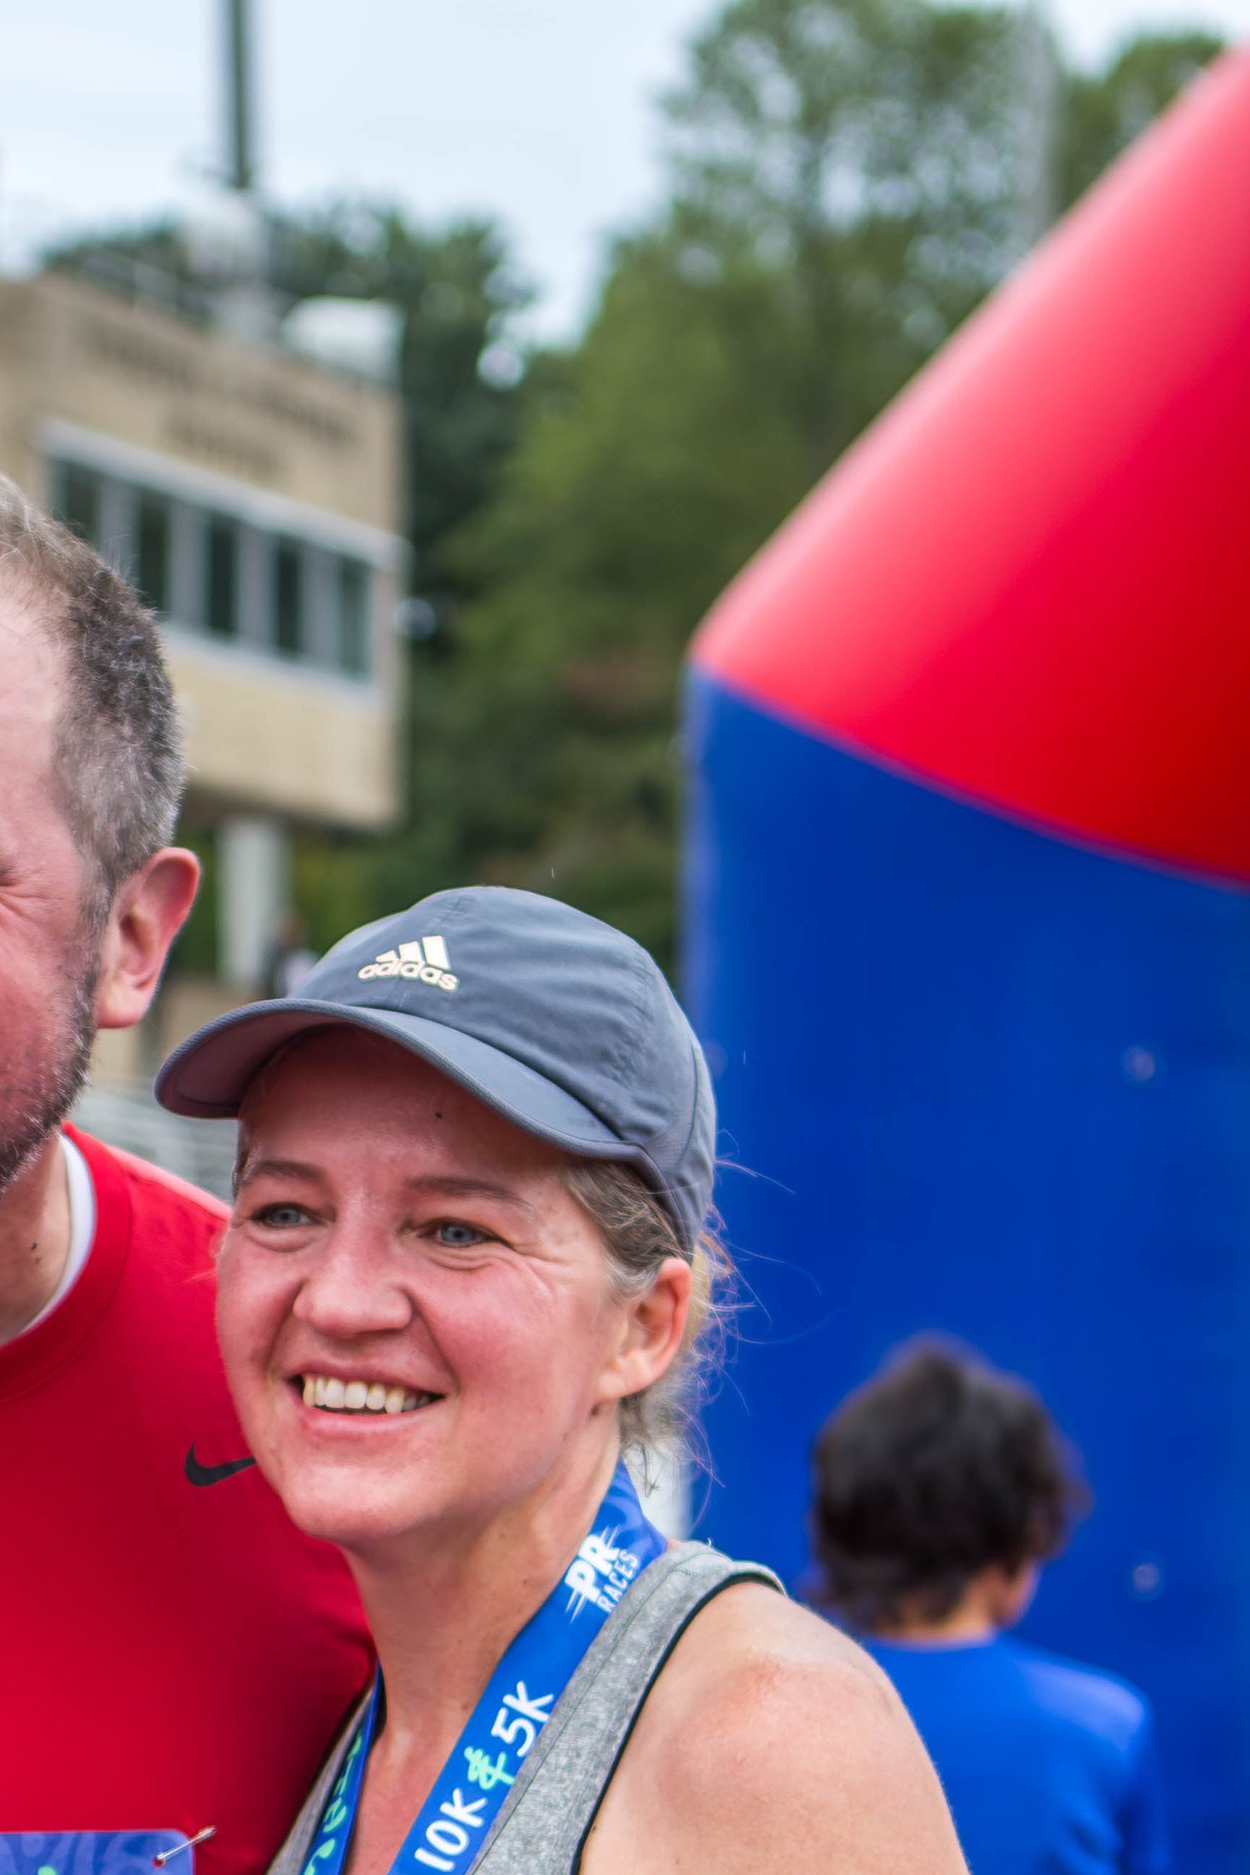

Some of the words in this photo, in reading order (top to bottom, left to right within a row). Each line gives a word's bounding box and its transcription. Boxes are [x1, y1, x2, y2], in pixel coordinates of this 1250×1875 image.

[358, 958, 458, 991] adidas
[565, 1533, 620, 1603] PR
[597, 1549, 638, 1613] RACES
[415, 1788, 486, 1873] 10K
[491, 1680, 554, 1757] 5K
